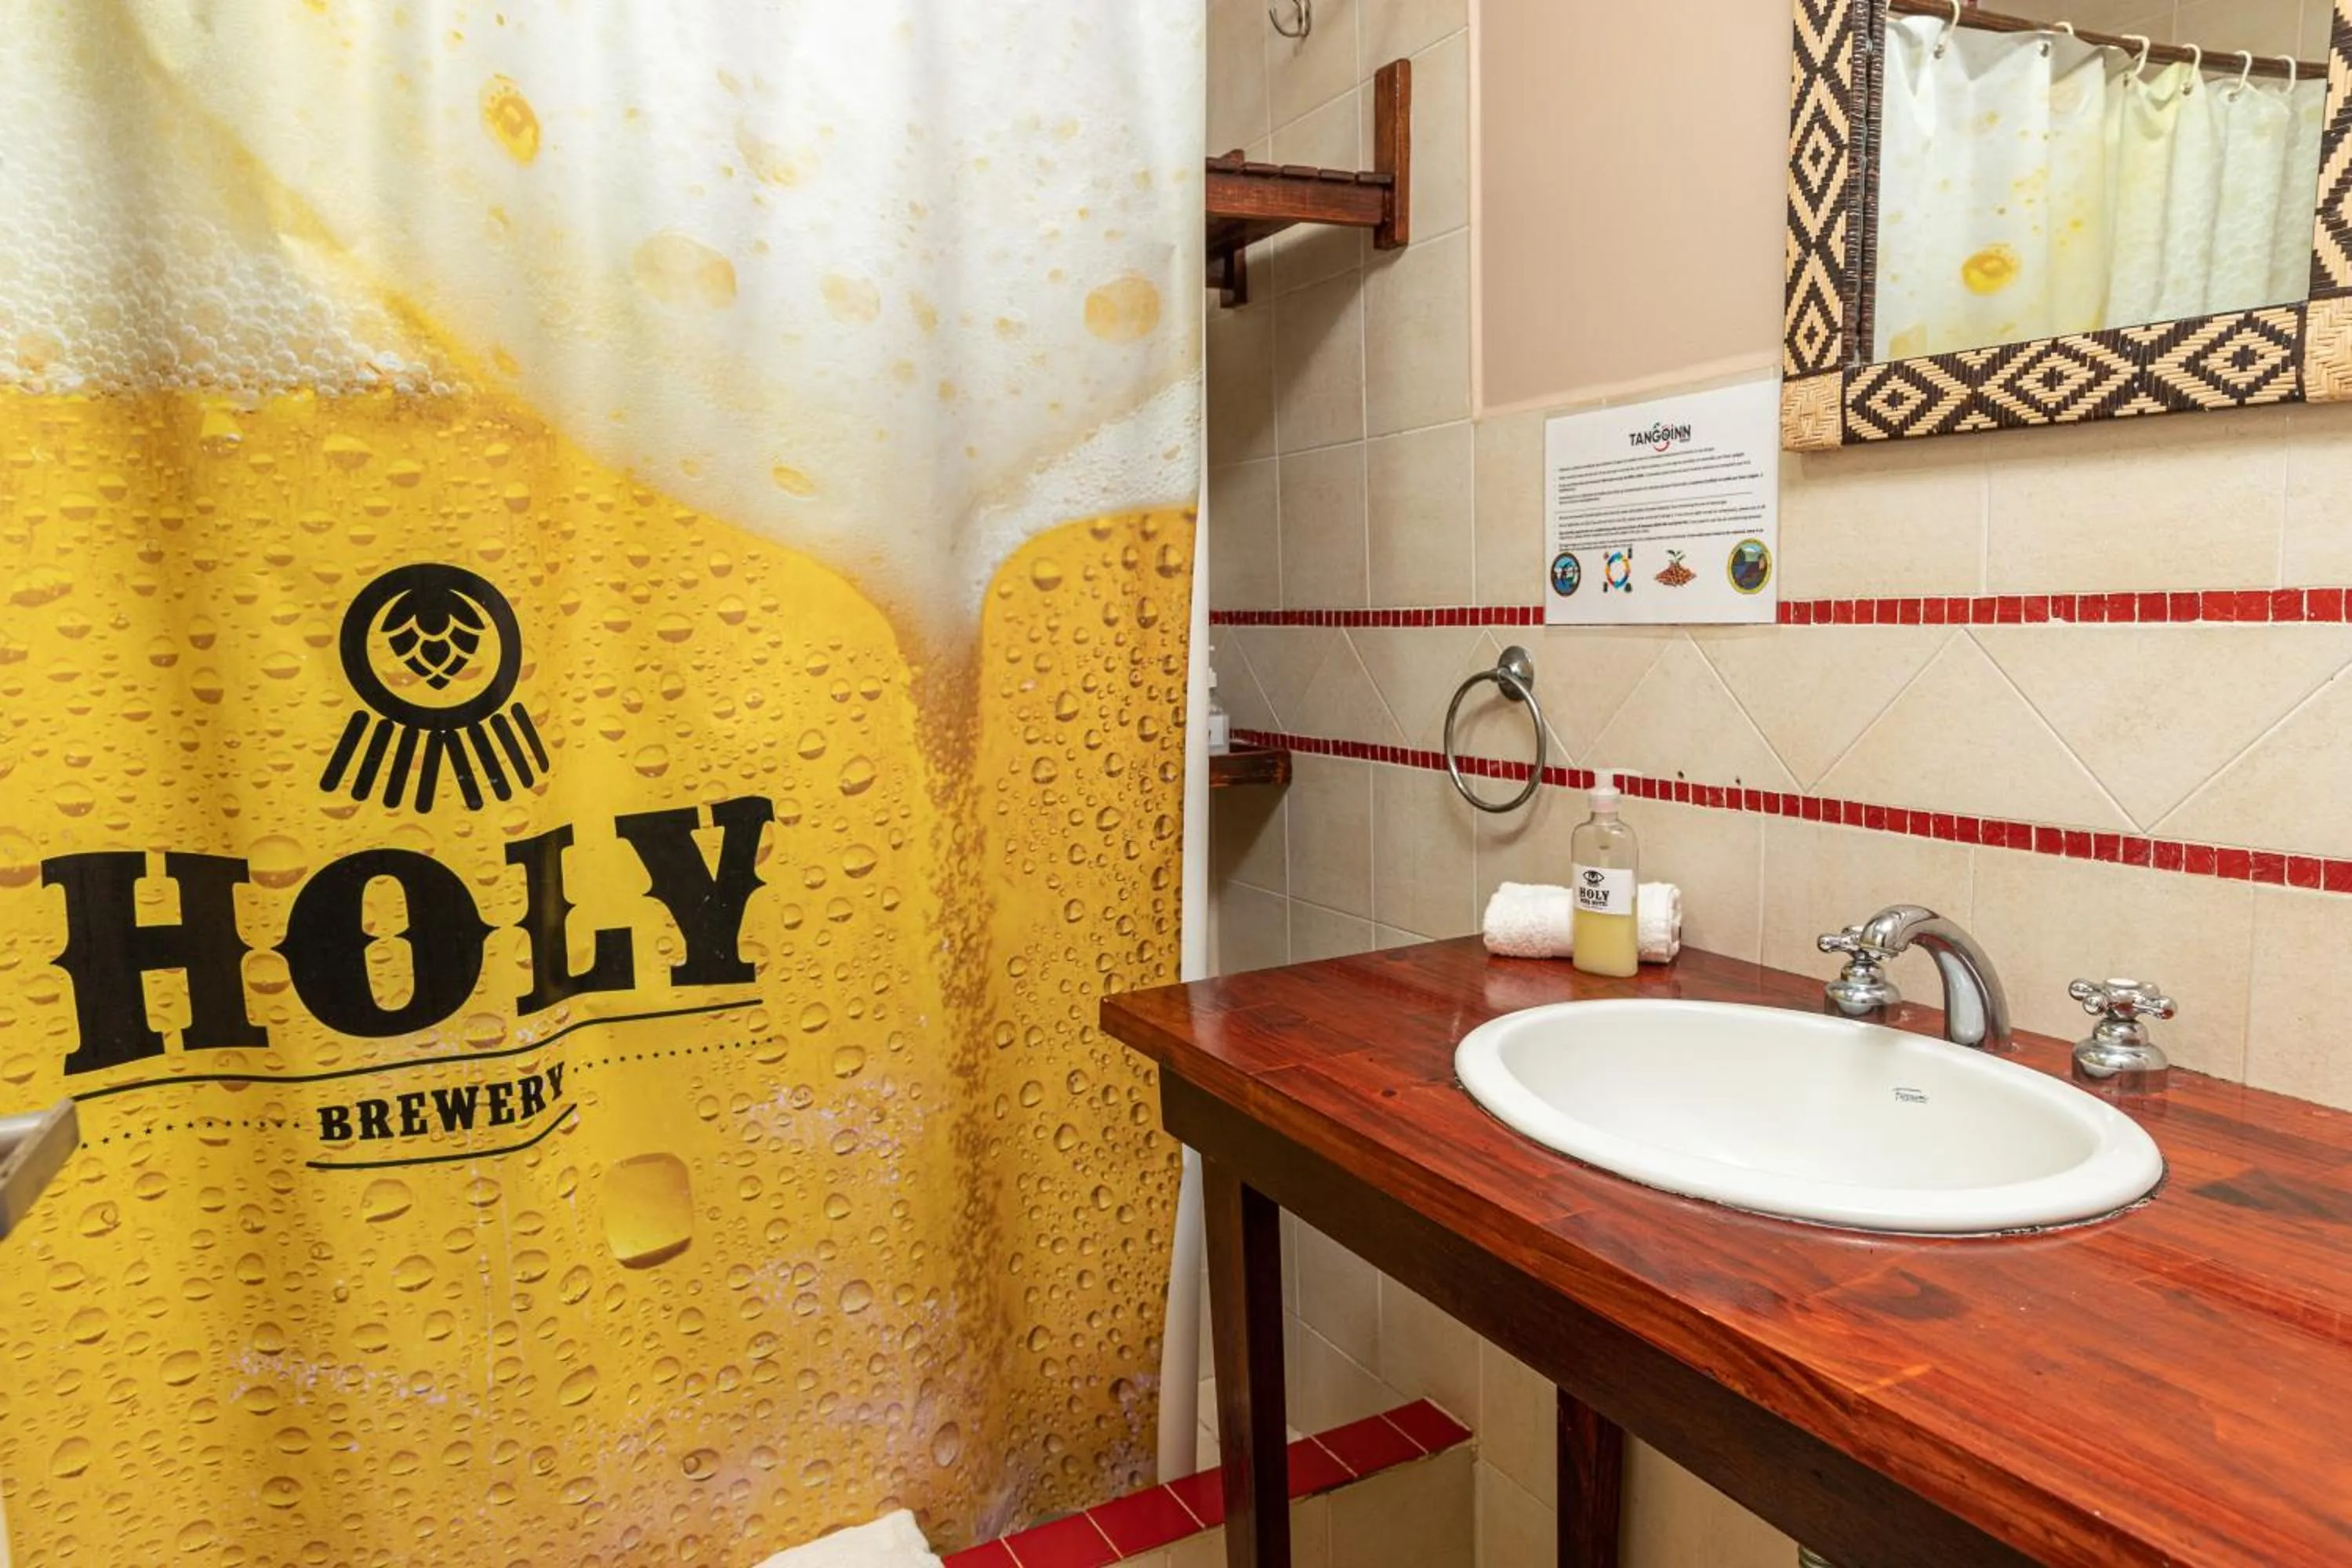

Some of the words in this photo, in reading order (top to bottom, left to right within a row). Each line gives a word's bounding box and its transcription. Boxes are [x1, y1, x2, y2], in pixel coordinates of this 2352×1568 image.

[1580, 887, 1610, 901] HOLY
[42, 795, 775, 1076] HOLY
[317, 1062, 565, 1140] BREWERY
